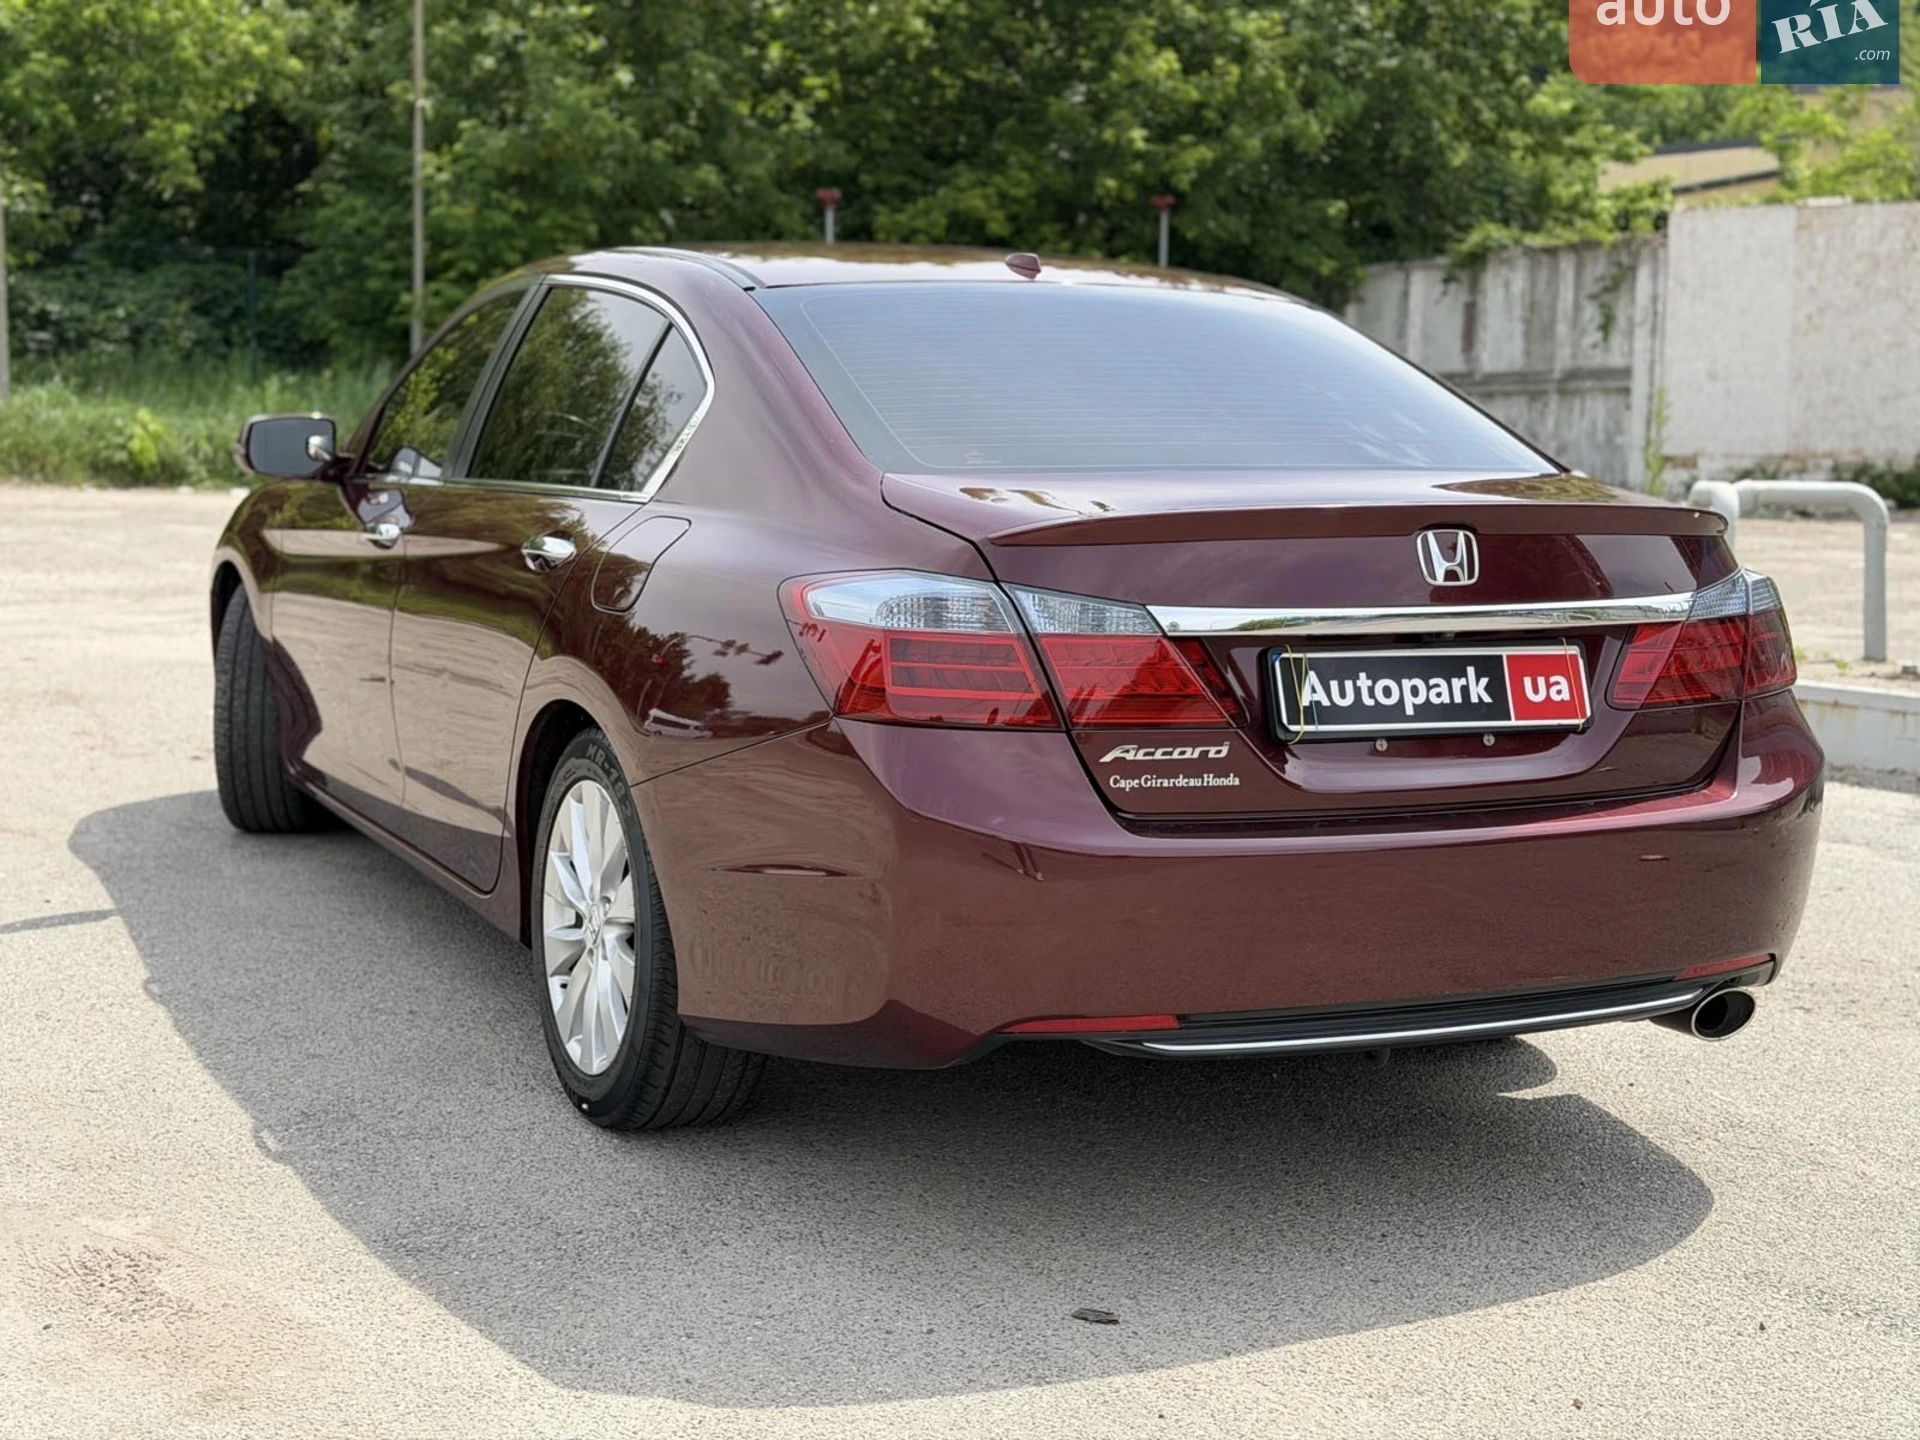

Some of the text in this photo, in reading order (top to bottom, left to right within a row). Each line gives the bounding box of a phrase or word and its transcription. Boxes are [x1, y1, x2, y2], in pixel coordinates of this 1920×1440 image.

[1302, 666, 1571, 716] Autopark ua
[1099, 741, 1230, 763] Accord
[1110, 773, 1240, 792] Cape Girardeau Honda
